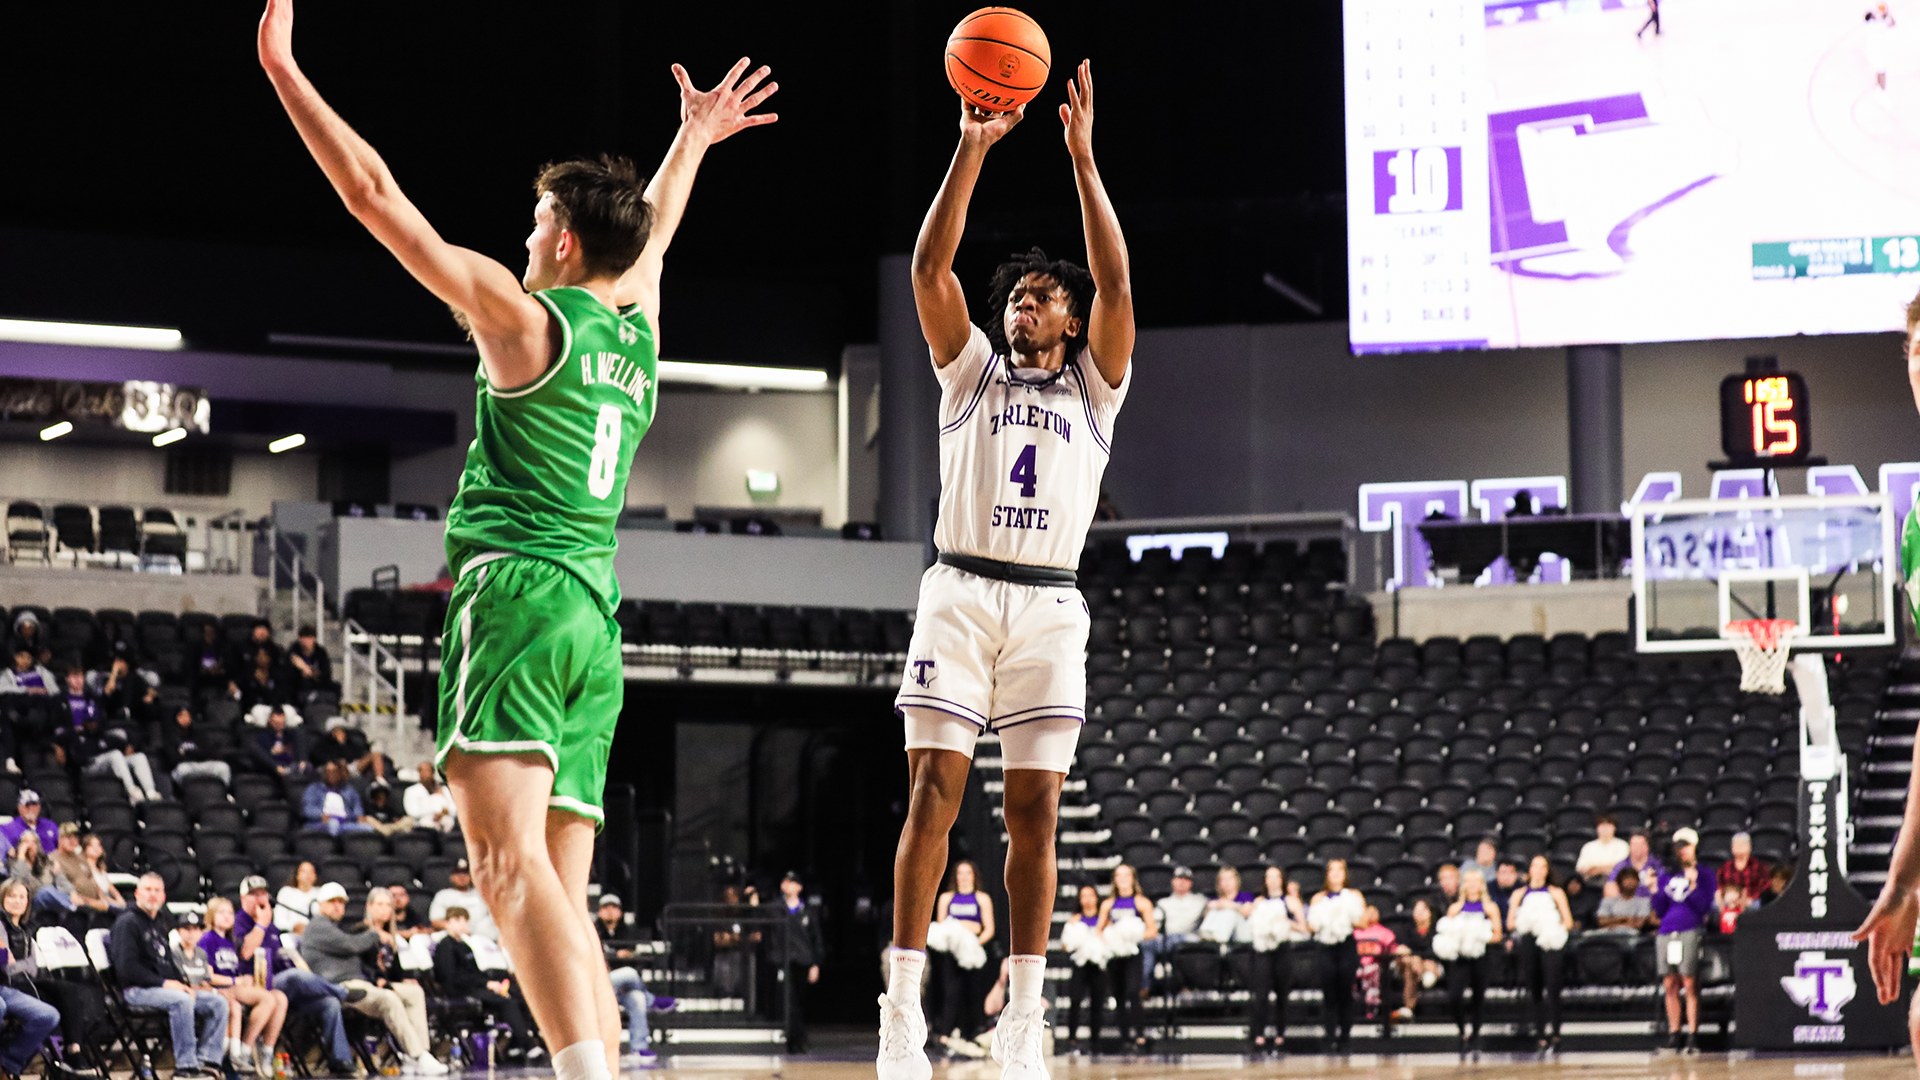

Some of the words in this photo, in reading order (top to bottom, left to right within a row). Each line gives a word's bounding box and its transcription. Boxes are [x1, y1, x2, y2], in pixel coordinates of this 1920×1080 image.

[1387, 146, 1449, 214] 10
[1882, 236, 1920, 268] 13
[580, 352, 596, 386] H.
[597, 351, 651, 407] WELLING
[587, 403, 622, 500] 8
[990, 404, 1072, 444] TRLETON
[1752, 399, 1798, 455] 15
[1009, 444, 1038, 498] 4
[991, 505, 1050, 531] STATE
[1807, 781, 1829, 919] TEXANS
